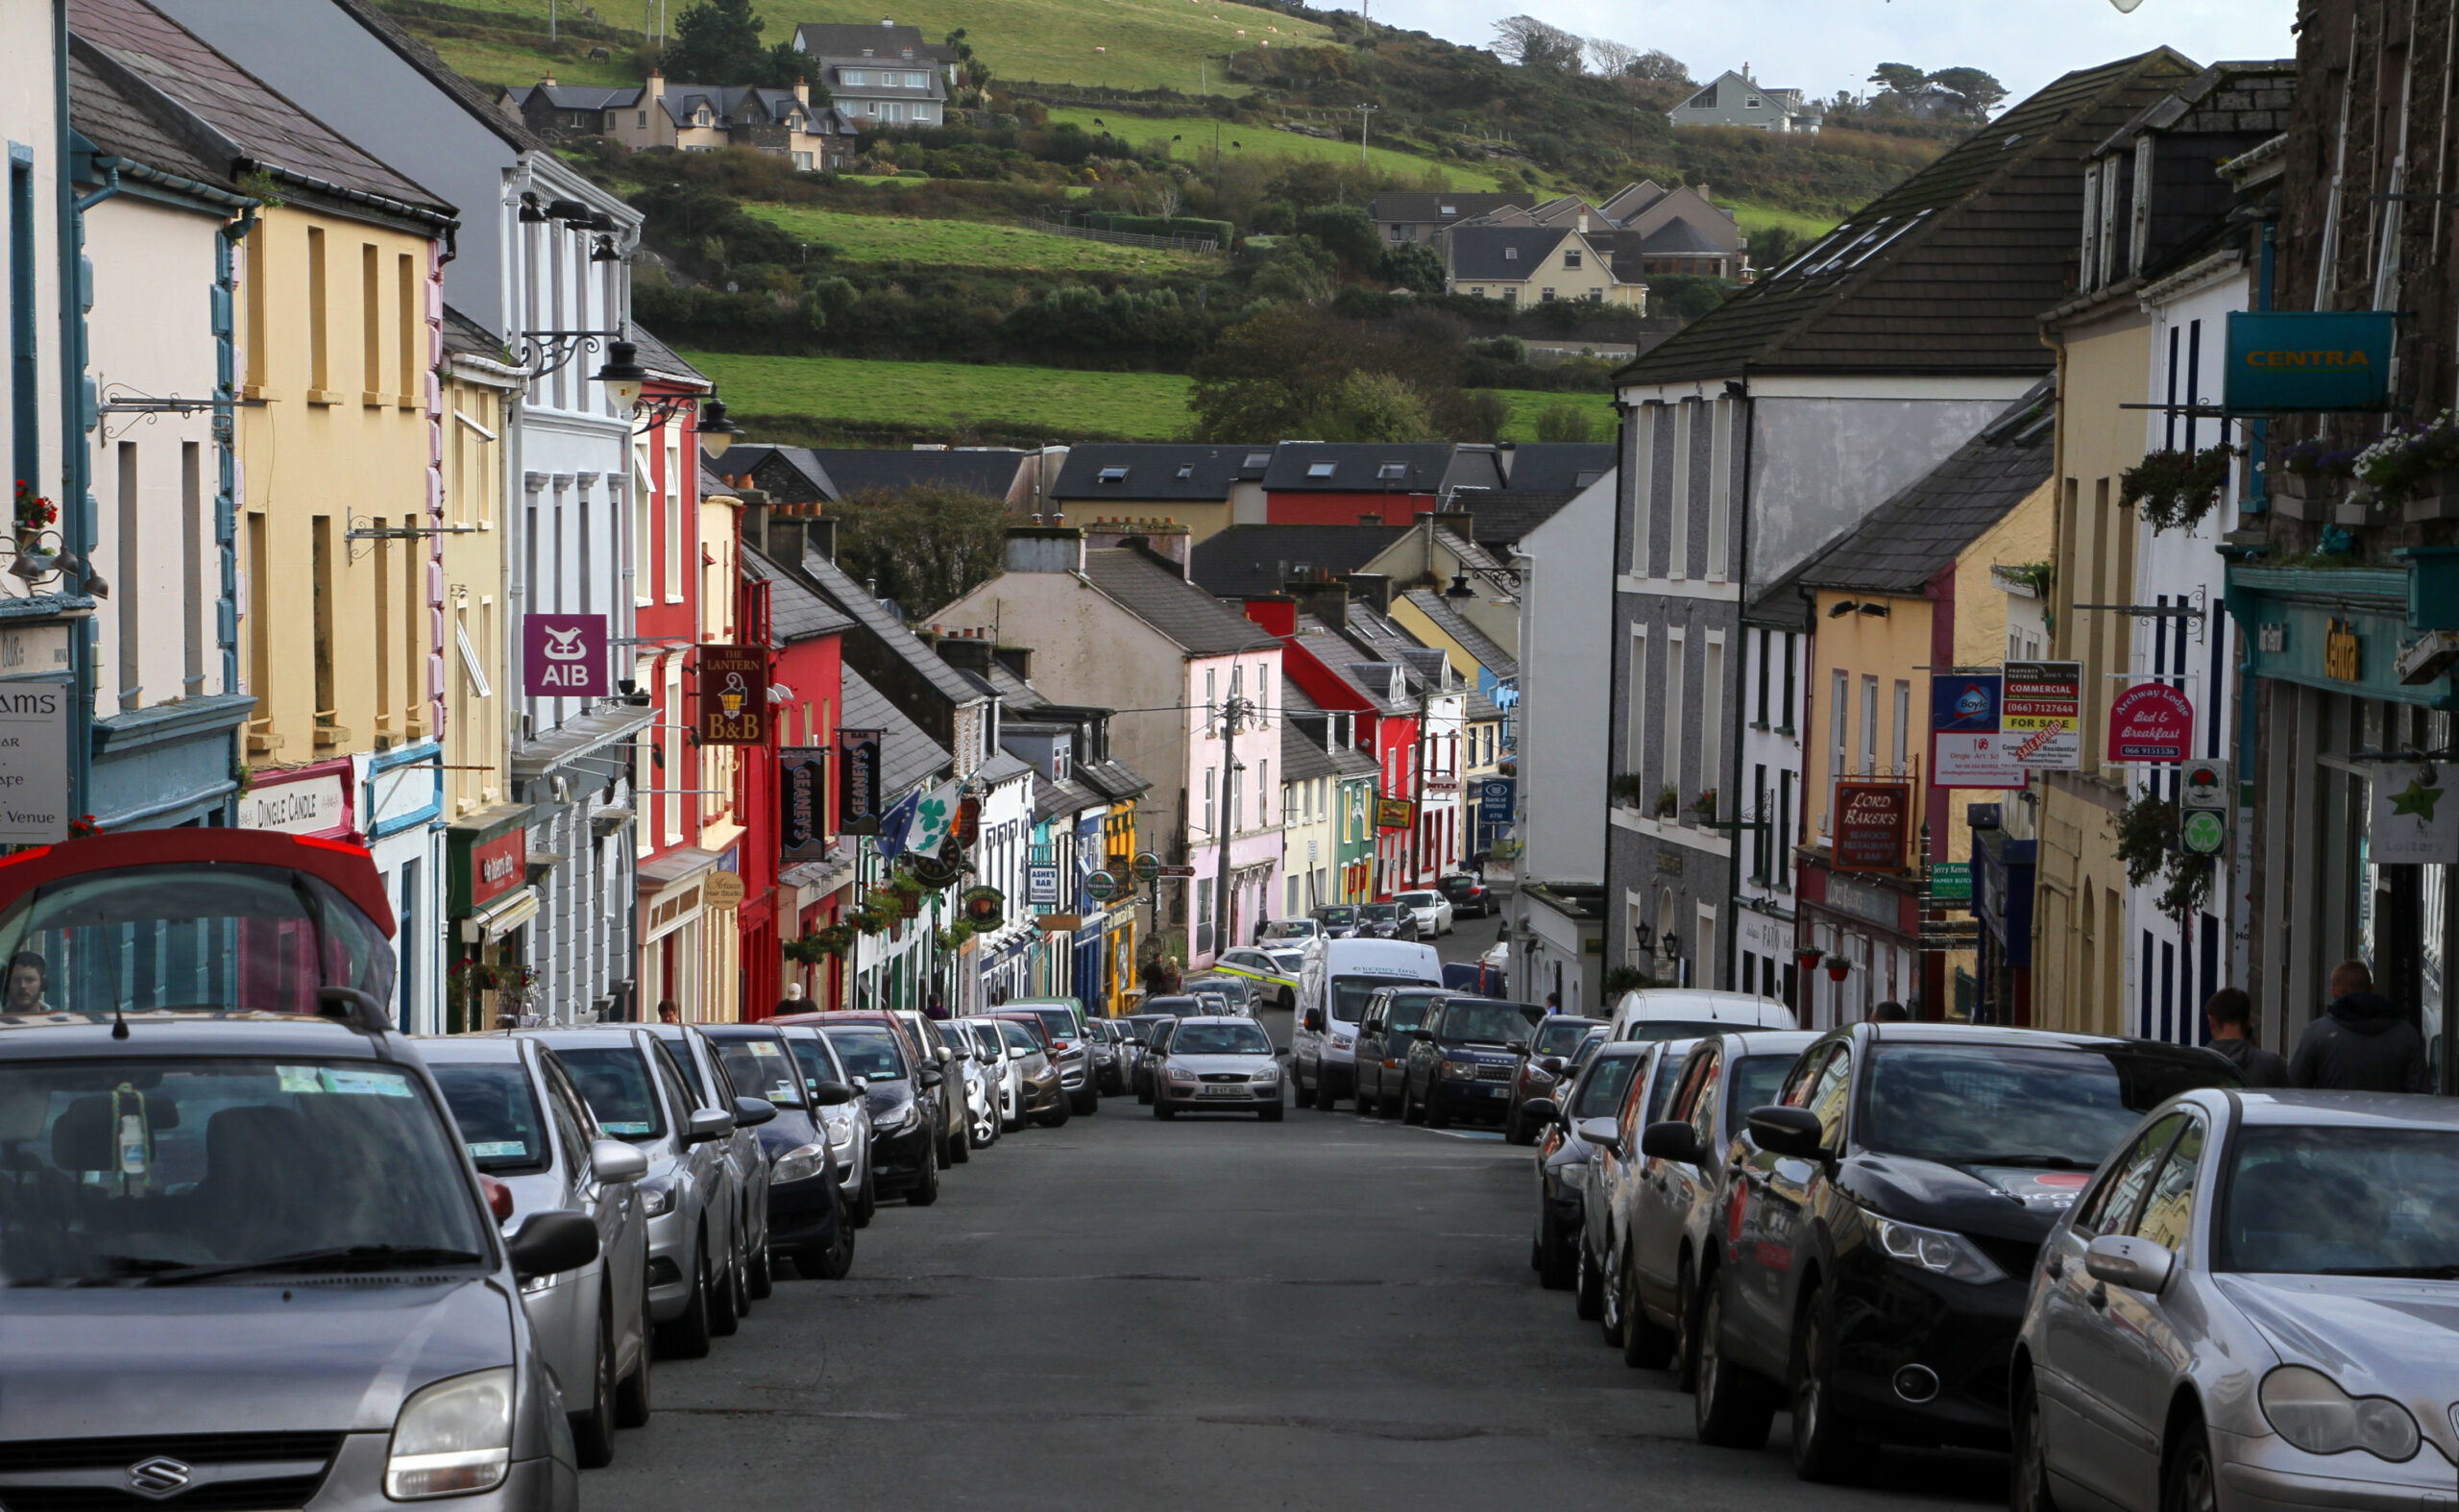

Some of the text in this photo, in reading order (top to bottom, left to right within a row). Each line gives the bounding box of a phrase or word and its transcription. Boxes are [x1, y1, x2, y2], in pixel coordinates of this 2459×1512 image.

[2246, 351, 2370, 366] CENTRA
[2325, 616, 2359, 681] Centra
[707, 660, 760, 670] LANTERN
[541, 664, 589, 687] AIB
[2009, 684, 2072, 694] COMMERCIAL
[2008, 702, 2074, 713] (066) 7127644
[2116, 689, 2189, 717] Archway Lodge
[2010, 719, 2070, 728] FOR SAE
[2133, 711, 2169, 722] Bed &
[708, 714, 760, 739] B&B
[2121, 726, 2180, 741] Breakfast
[2017, 720, 2062, 760] SALE AGREED
[851, 749, 869, 817] GEANEY'S
[794, 768, 812, 841] GEANEY'S
[1851, 792, 1891, 807] LORD
[7, 811, 55, 824] Venue
[257, 793, 316, 828] DINGLE CANDLE
[1844, 809, 1898, 824] BAKER'S
[1934, 865, 1949, 874] Jerry
